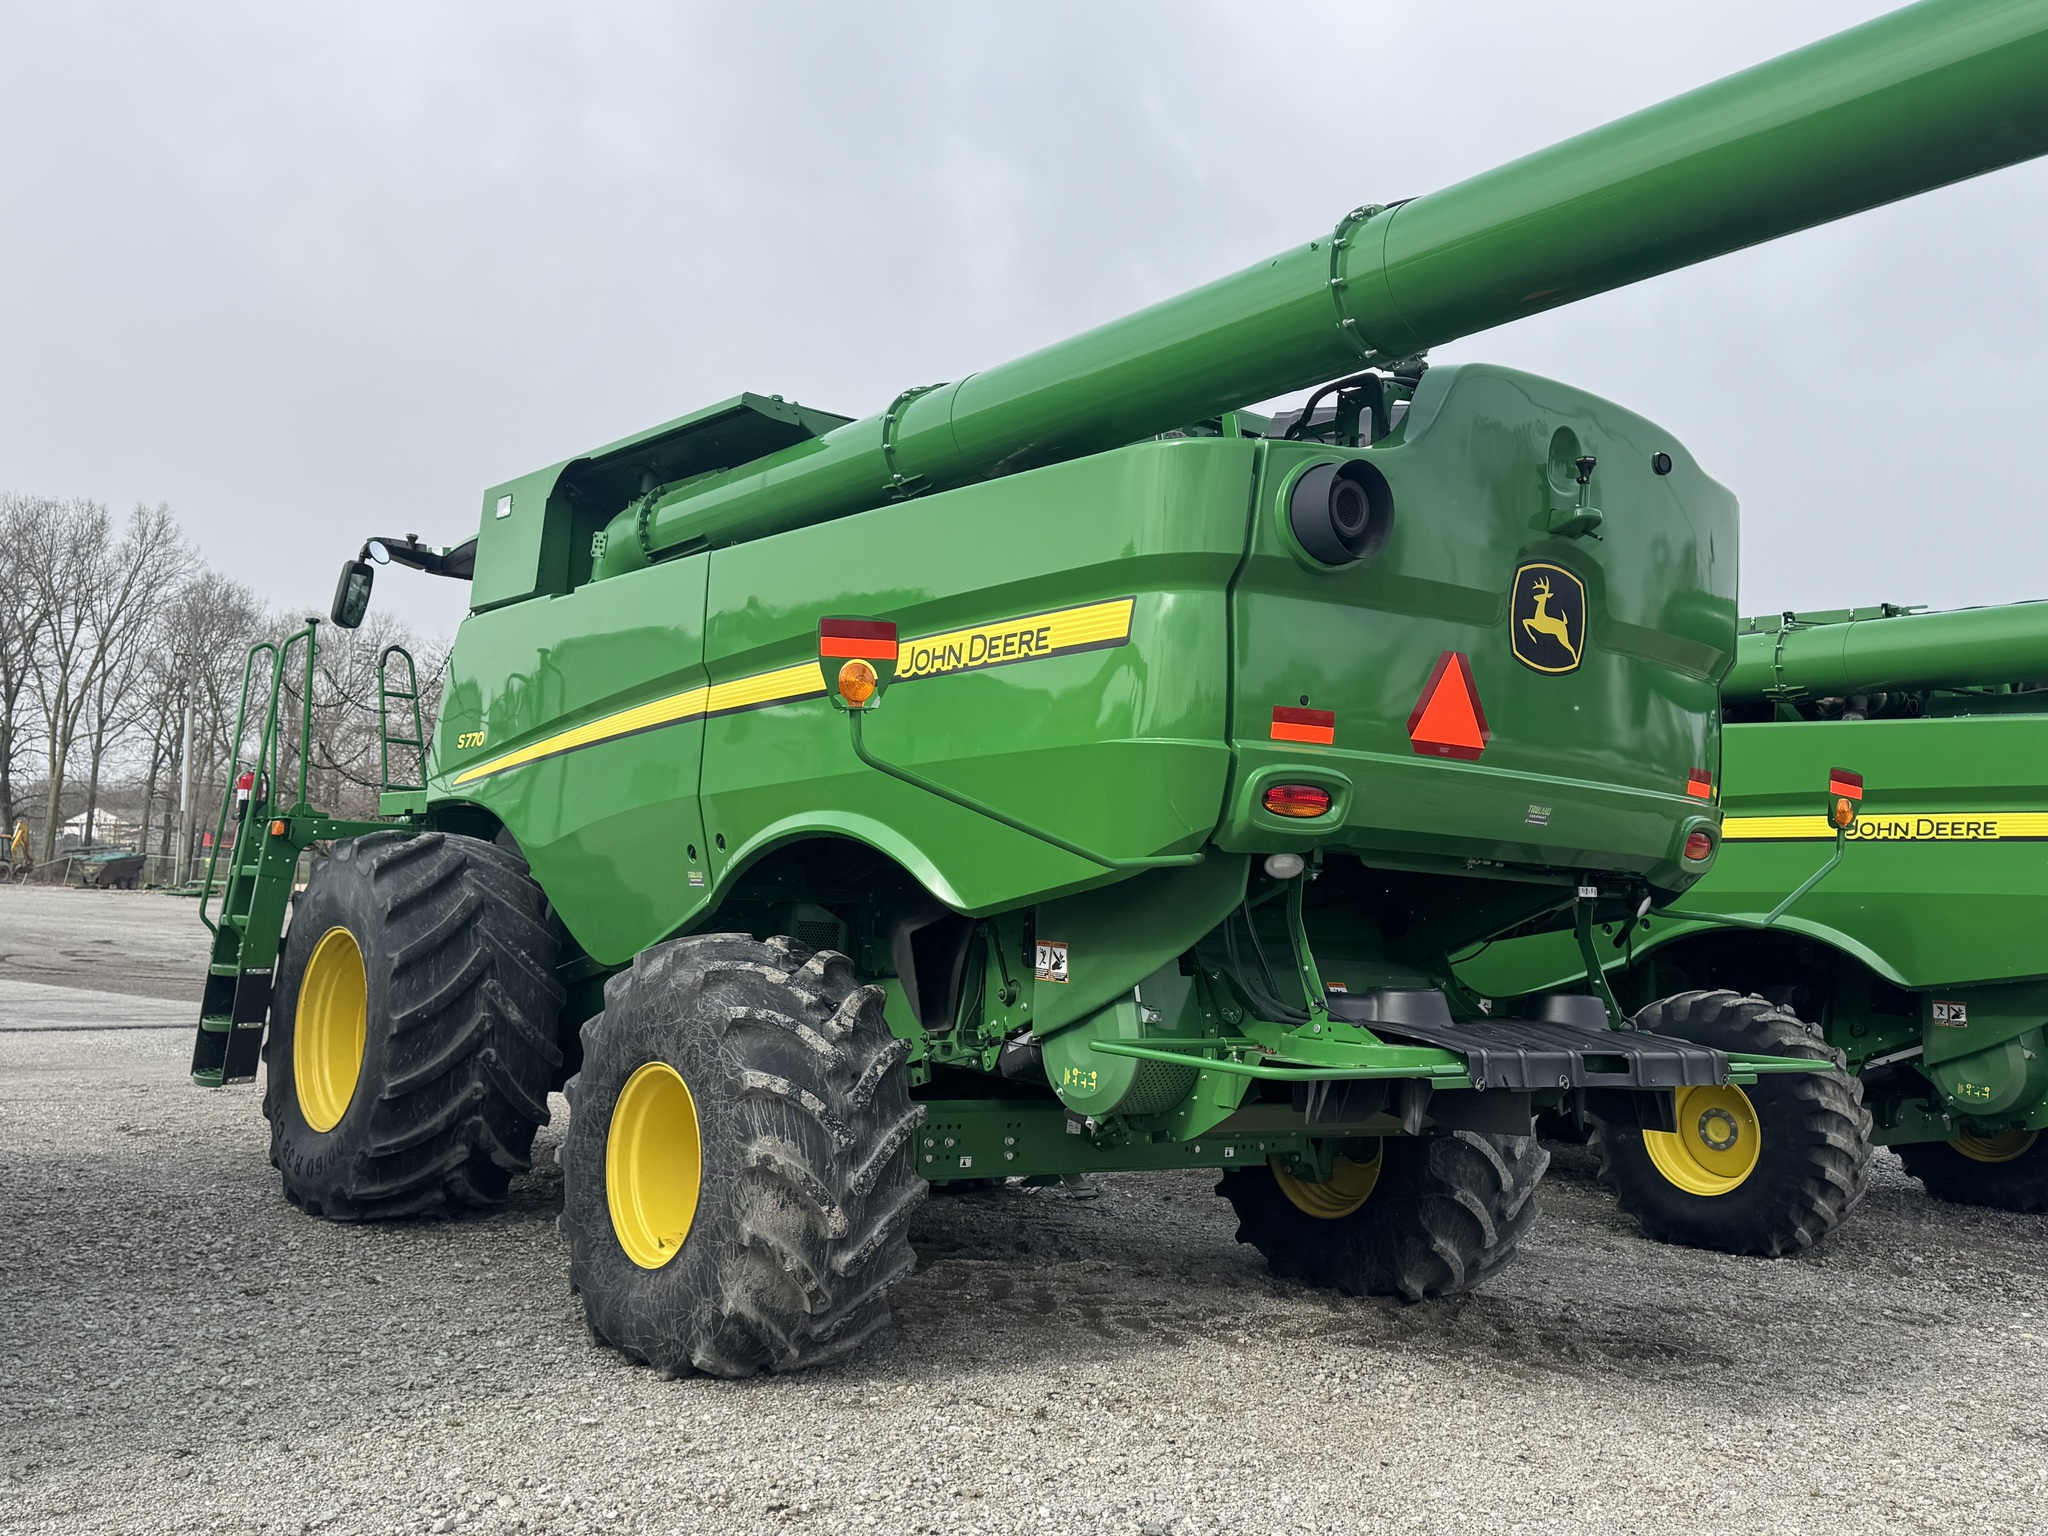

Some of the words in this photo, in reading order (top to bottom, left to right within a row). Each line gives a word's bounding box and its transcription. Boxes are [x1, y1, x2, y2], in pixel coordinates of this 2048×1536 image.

[902, 642, 963, 674] JOHN
[969, 626, 1051, 662] DEERE
[457, 731, 485, 749] S770
[1846, 819, 1909, 837] JOHN
[1916, 819, 1998, 837] DEERE
